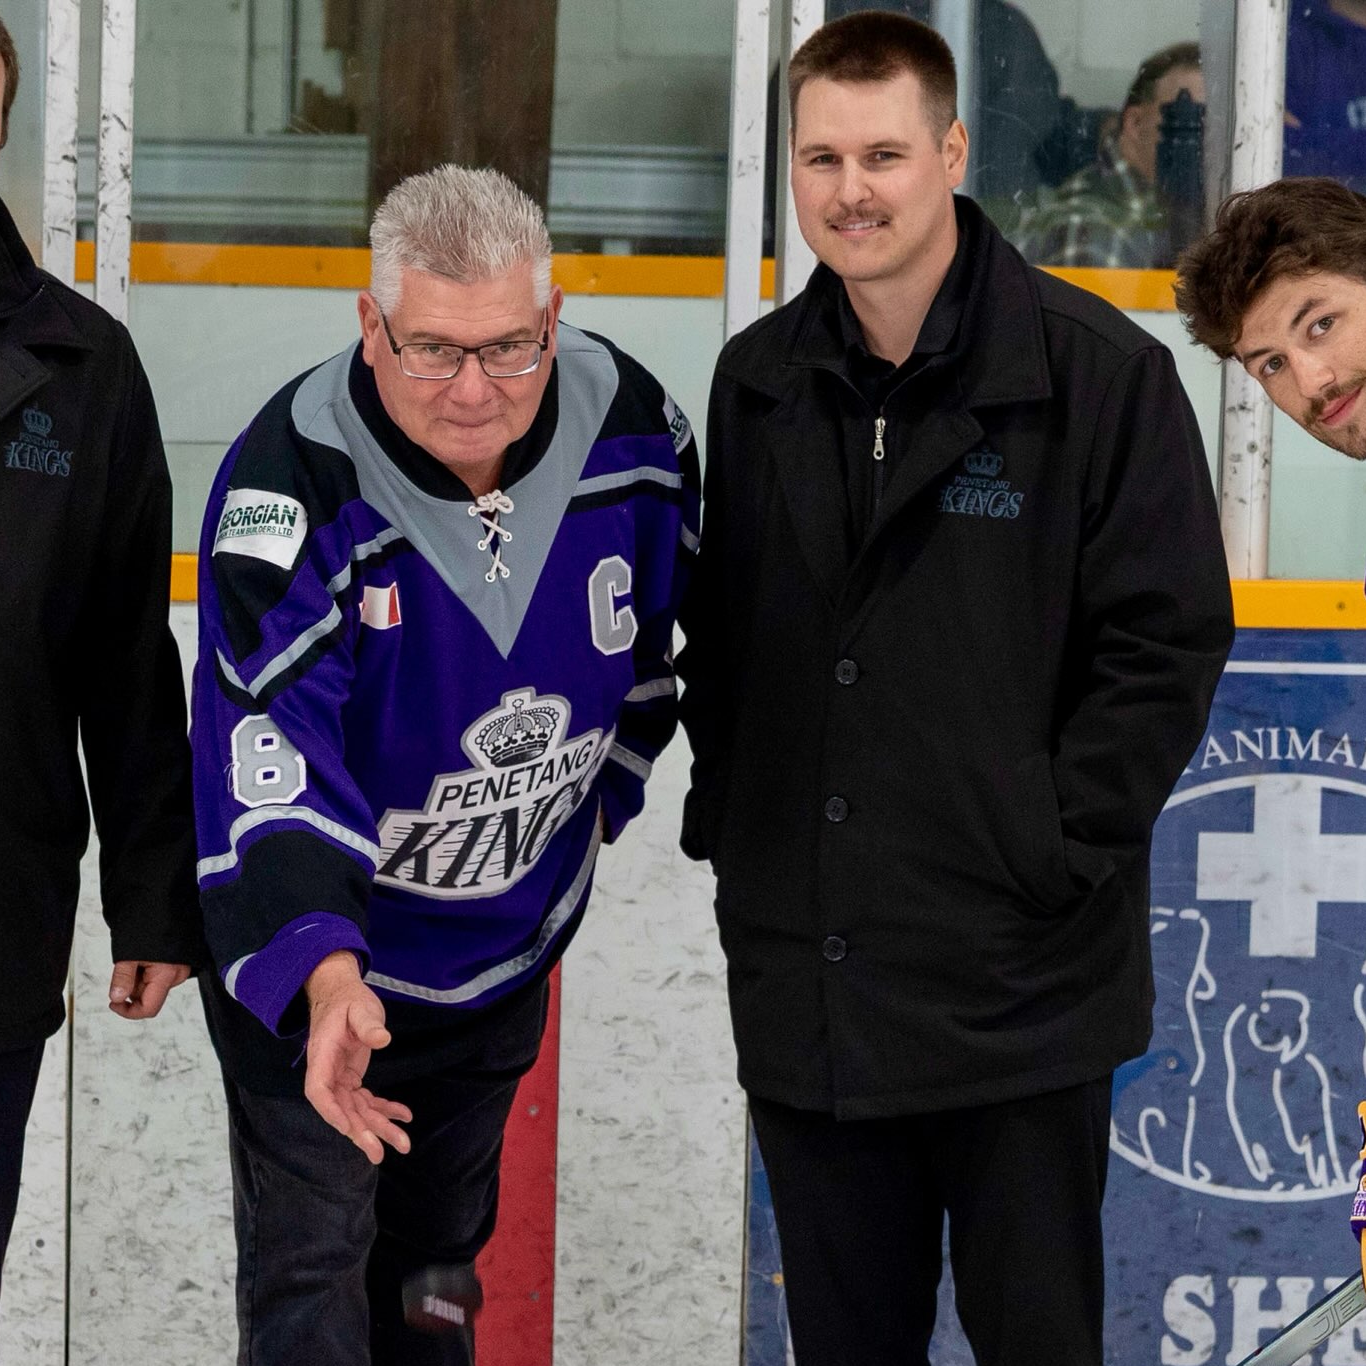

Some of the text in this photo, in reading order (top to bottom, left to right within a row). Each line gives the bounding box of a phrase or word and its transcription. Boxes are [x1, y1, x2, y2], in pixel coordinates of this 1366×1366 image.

[4, 441, 73, 477] KINGS
[941, 486, 1024, 518] KINGS
[588, 555, 638, 656] C
[230, 714, 307, 809] 8
[436, 739, 594, 812] PENETANG
